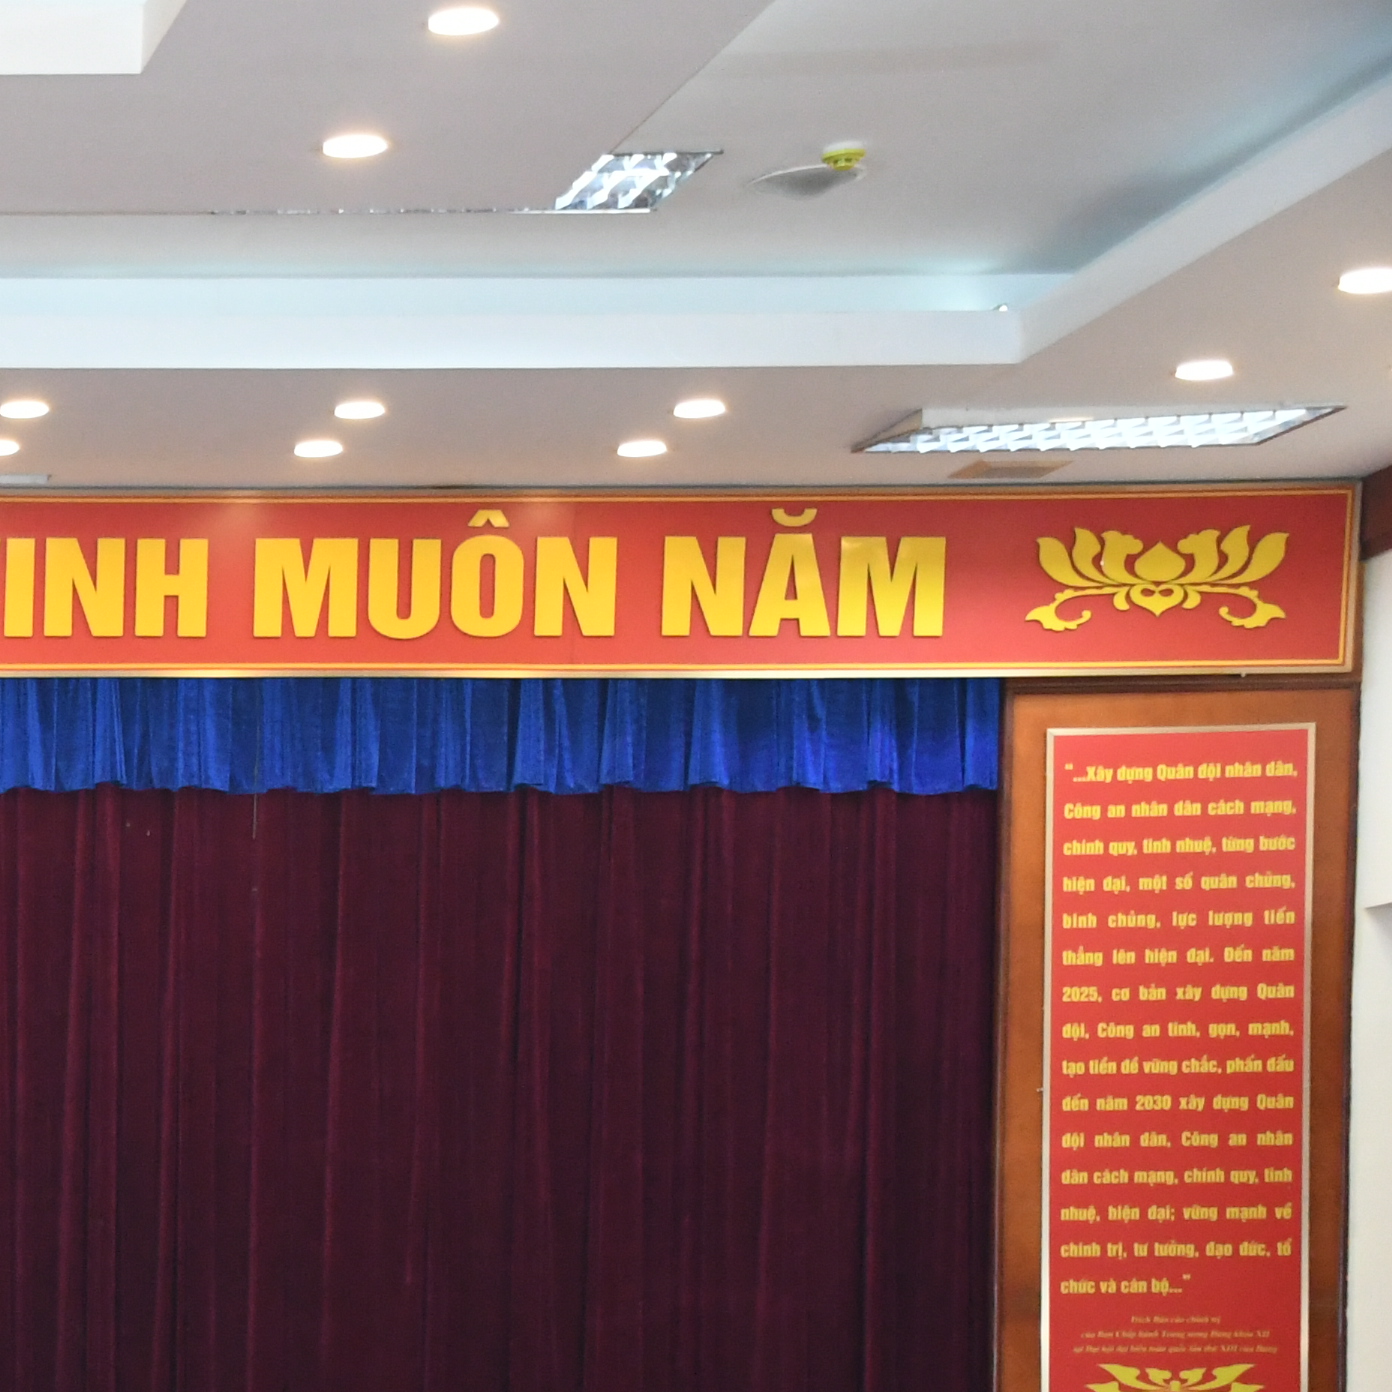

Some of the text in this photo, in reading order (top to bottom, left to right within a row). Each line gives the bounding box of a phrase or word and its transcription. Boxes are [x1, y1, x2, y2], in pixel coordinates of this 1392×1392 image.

[255, 511, 616, 638] MUÔN
[663, 510, 944, 636] NĂM
[1116, 765, 1154, 784] dựng
[1156, 764, 1195, 781] Quân
[1197, 763, 1222, 782] đội
[1224, 762, 1263, 778] nhân
[1063, 802, 1102, 821] Công
[1106, 805, 1126, 818] an
[1131, 801, 1169, 817] nhân
[1173, 800, 1202, 815] dân
[1207, 799, 1245, 815] cách
[1062, 839, 1105, 856] chính
[1062, 876, 1096, 895] hiện
[1138, 875, 1168, 893] một
[1175, 873, 1194, 890] số
[1200, 874, 1238, 890] quân
[1062, 913, 1098, 929] binh
[1172, 911, 1197, 929] lực
[1208, 910, 1254, 928] lượng
[1263, 907, 1296, 924] tiến
[1111, 987, 1131, 1001] cơ
[1138, 984, 1167, 1000] bản
[1175, 984, 1203, 1001] xây
[1210, 984, 1248, 1002] dựng
[1256, 983, 1295, 1000] Quân
[1096, 1022, 1135, 1039] Công
[1141, 1024, 1161, 1037] an
[1061, 1093, 1295, 1112] đến năm 2030 xây dựng Quân
[1061, 1132, 1086, 1150] đội
[1093, 1132, 1131, 1147] nhân
[1181, 1131, 1219, 1147] Công
[1228, 1134, 1247, 1146] an
[1256, 1131, 1294, 1146] nhân
[1060, 1169, 1089, 1184] dân
[1092, 1169, 1130, 1184] cách
[1183, 1168, 1225, 1182] chính
[1107, 1205, 1141, 1223] hiện
[1182, 1205, 1218, 1221] vững
[1225, 1205, 1267, 1222] mạnh
[1274, 1202, 1293, 1219] về
[1060, 1279, 1096, 1294] chức
[1099, 1278, 1117, 1293] và
[1120, 1278, 1148, 1293] cán
